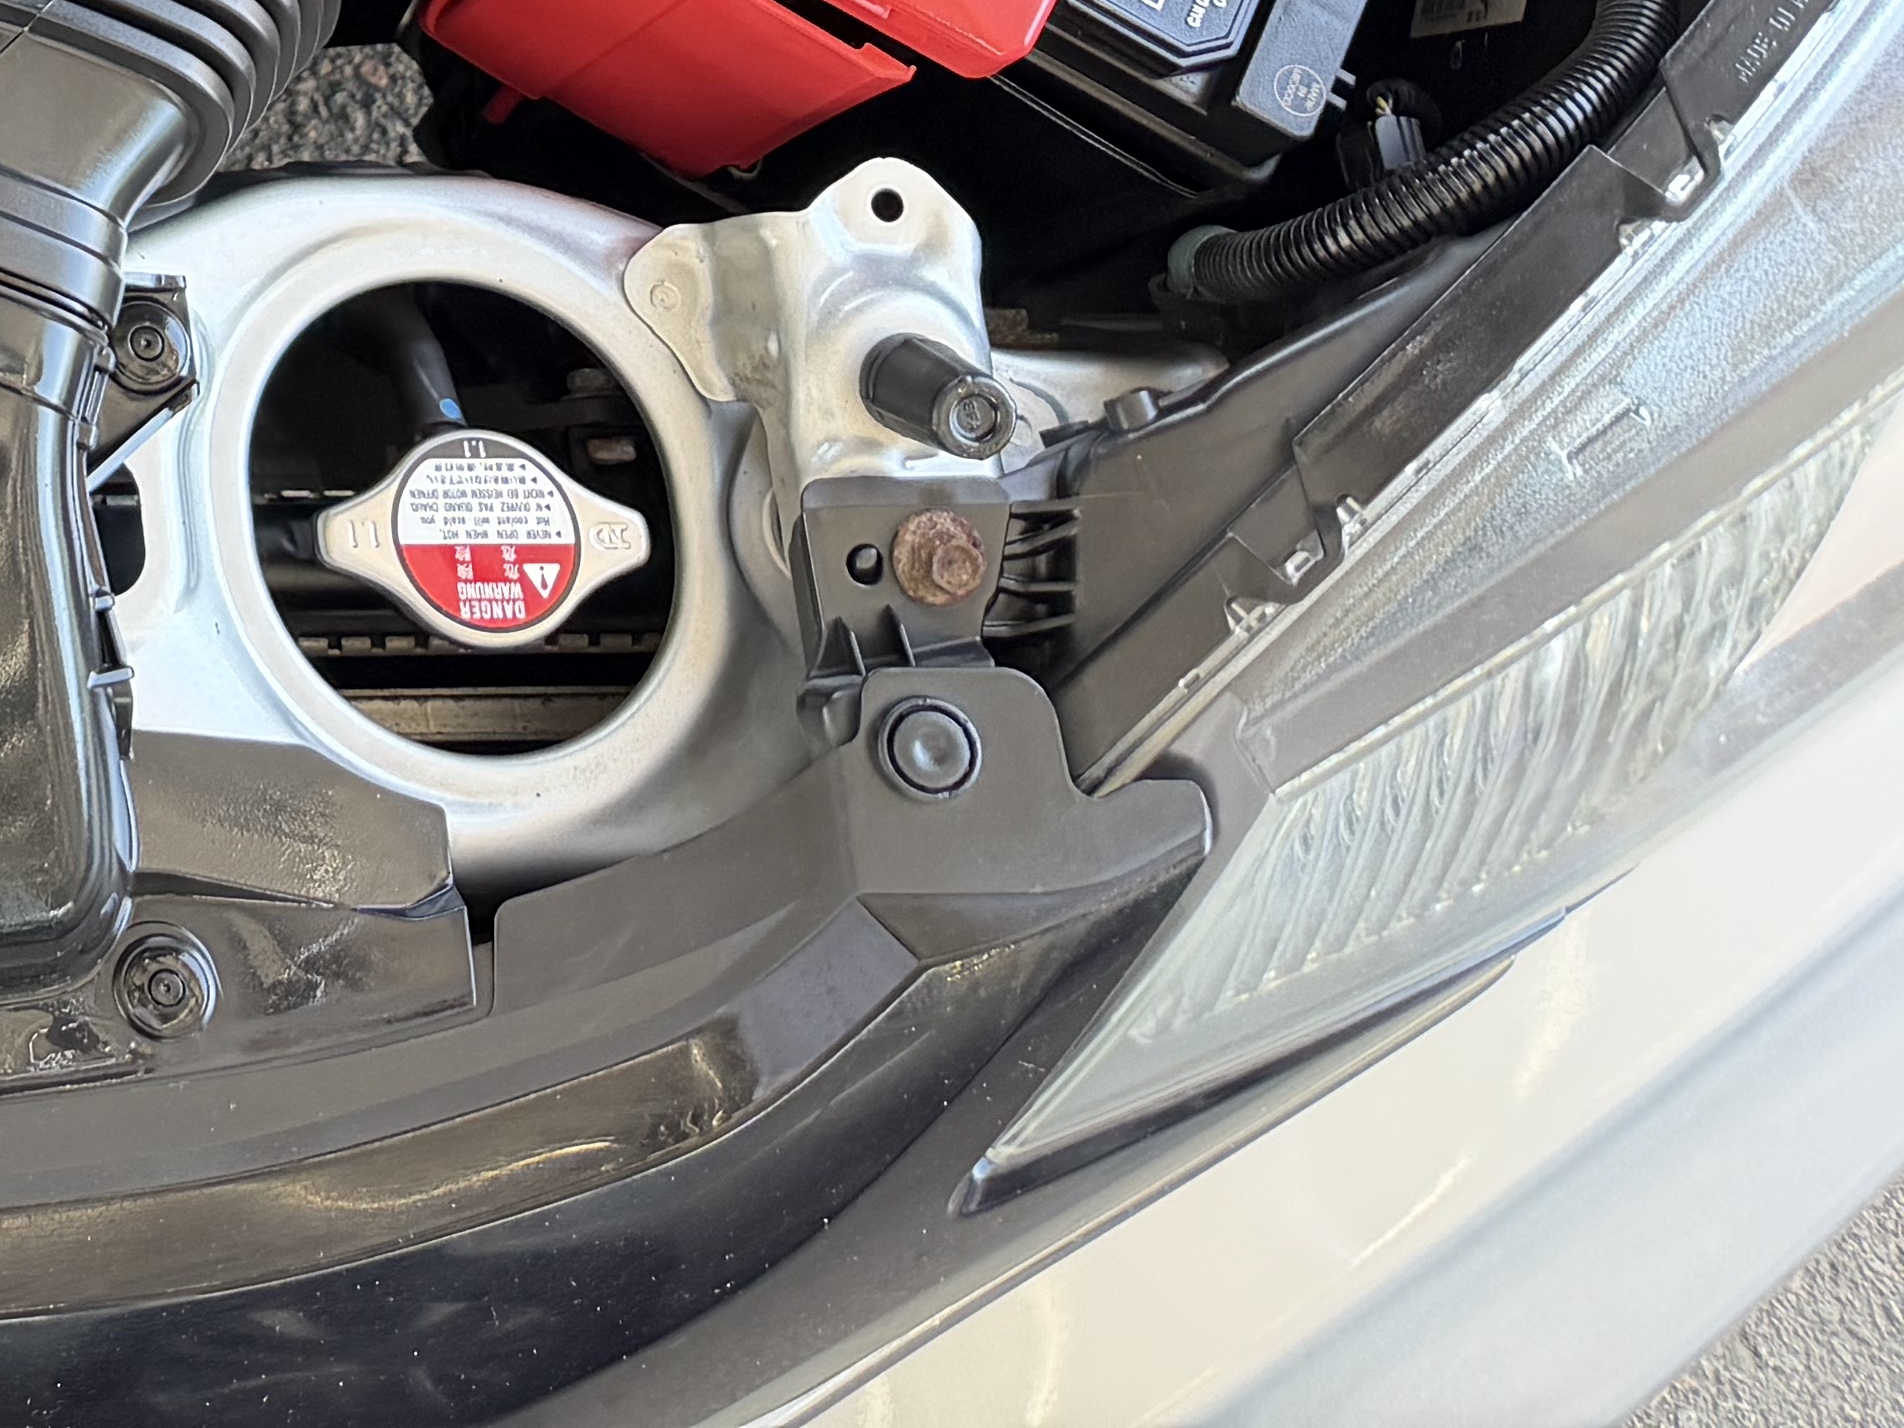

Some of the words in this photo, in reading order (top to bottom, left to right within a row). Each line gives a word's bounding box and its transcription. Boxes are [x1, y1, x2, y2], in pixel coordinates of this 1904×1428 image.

[462, 439, 486, 457] 1.1
[477, 502, 493, 512] PAS
[443, 515, 465, 525] scald
[473, 515, 489, 525] will
[497, 515, 528, 525] coolant
[465, 529, 488, 539] WHEN
[496, 529, 518, 539] OPEN
[526, 529, 551, 539] NEVER
[456, 581, 523, 599] WARNUNG
[458, 599, 525, 618] DANGER
